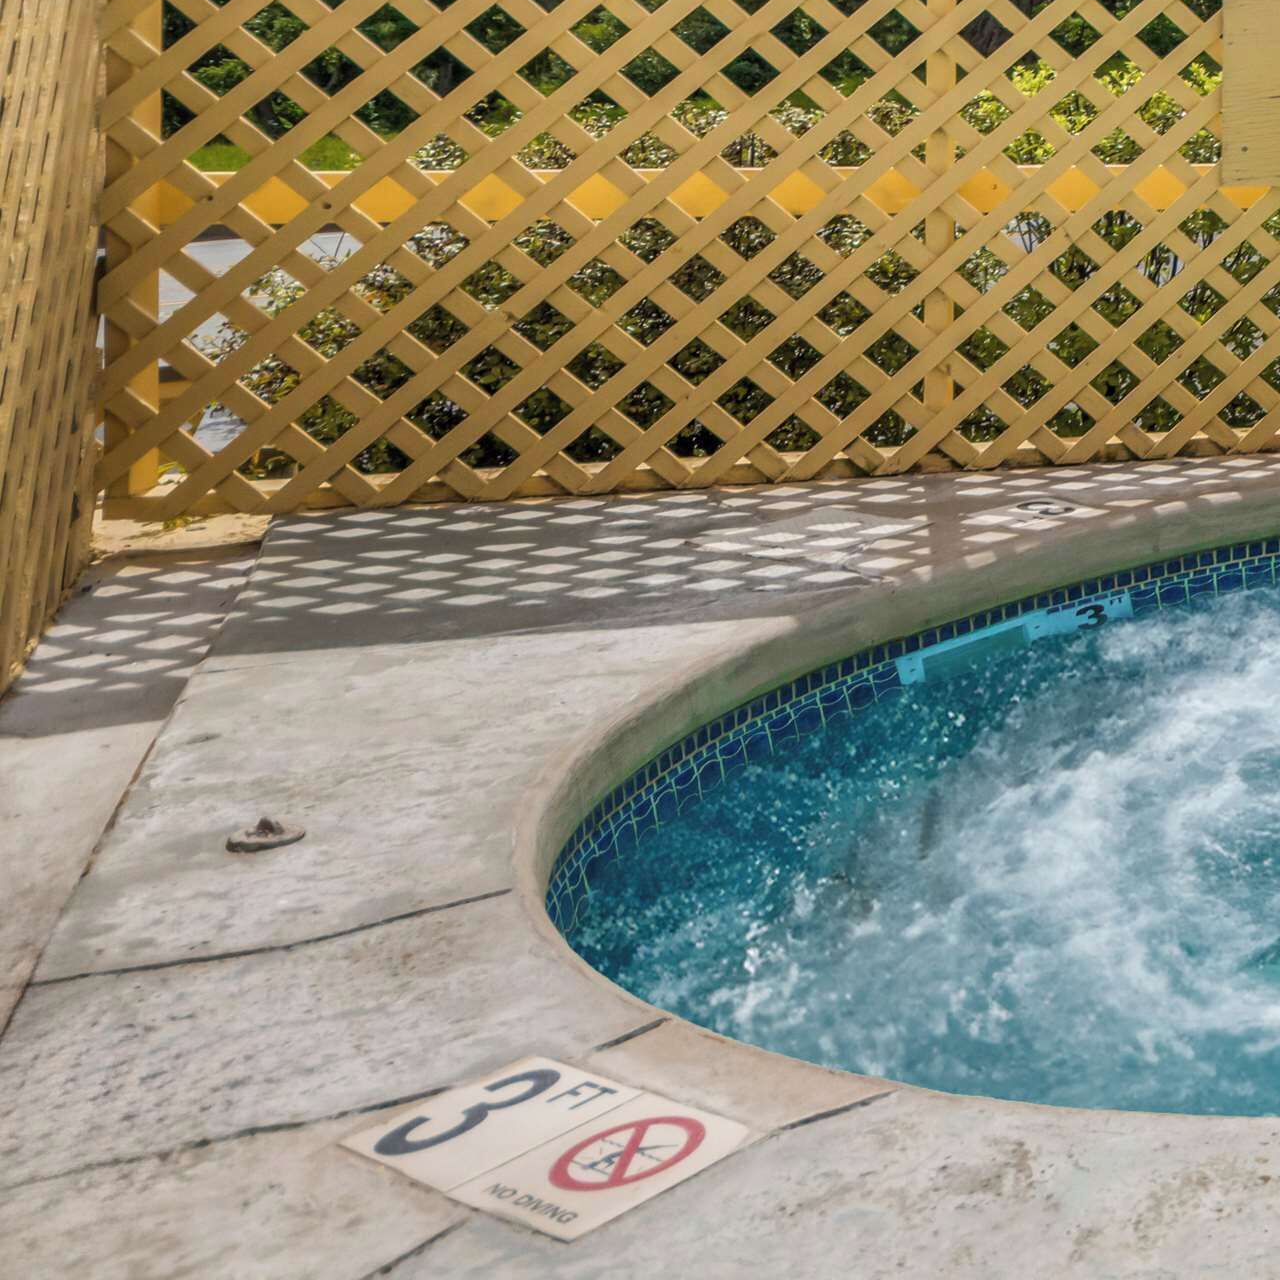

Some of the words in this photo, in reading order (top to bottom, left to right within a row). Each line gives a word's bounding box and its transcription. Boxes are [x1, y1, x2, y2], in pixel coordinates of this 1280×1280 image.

[1075, 604, 1107, 629] 3
[373, 1068, 561, 1156] 3
[545, 1081, 618, 1111] FT
[484, 1182, 518, 1199] NO
[512, 1194, 579, 1224] DIVING
